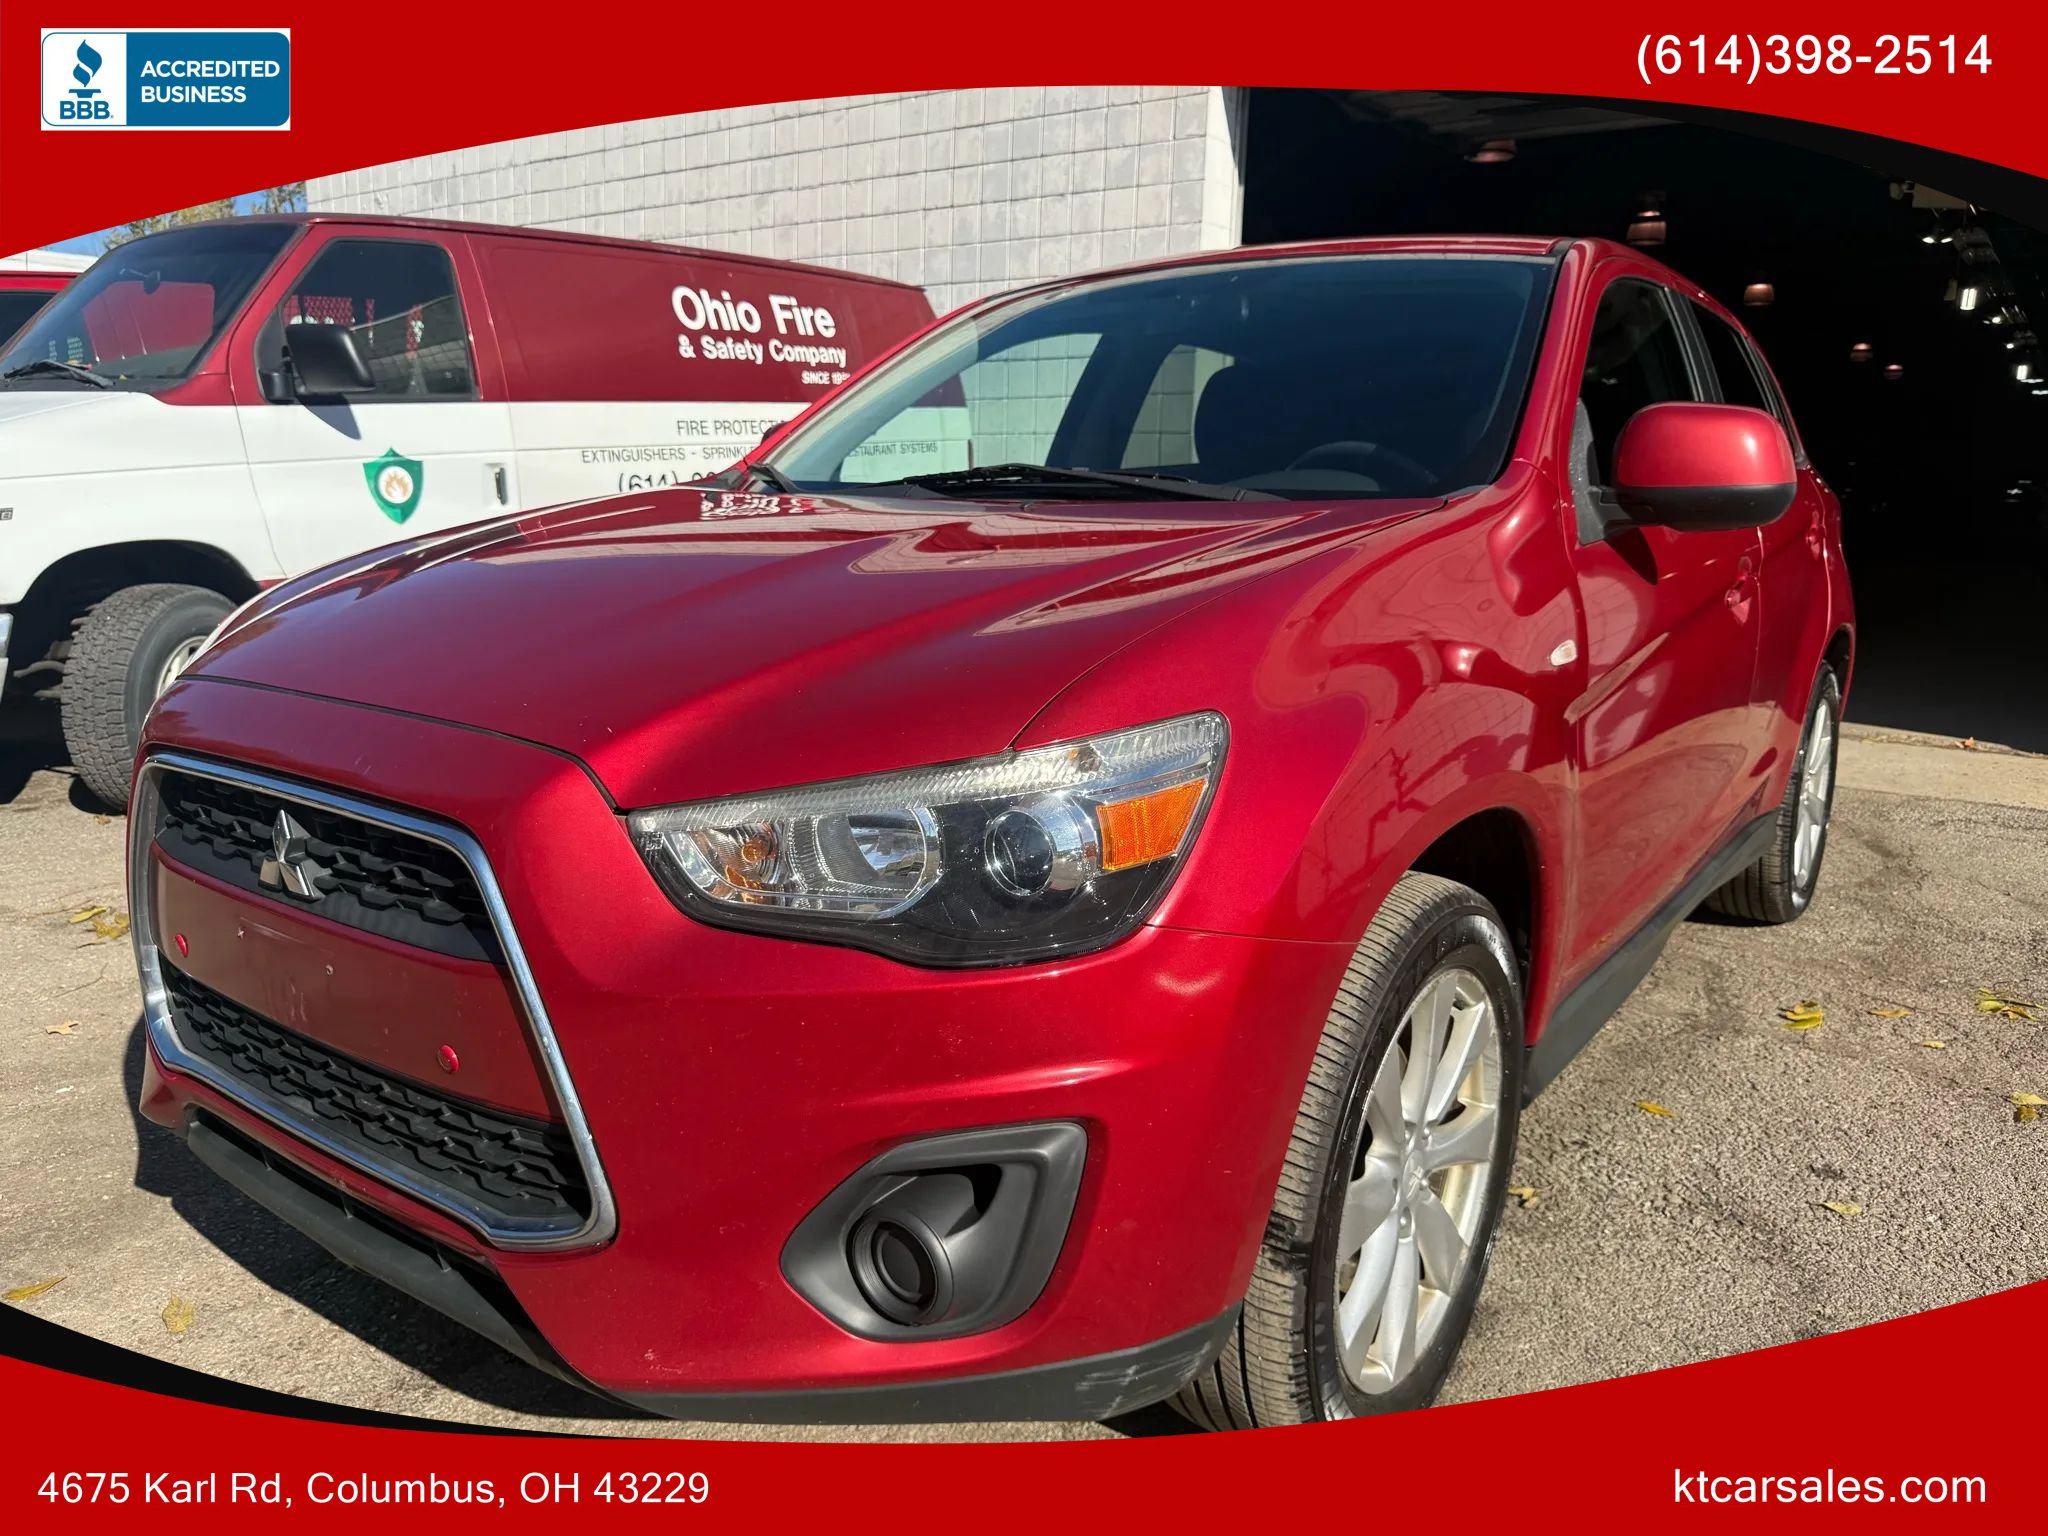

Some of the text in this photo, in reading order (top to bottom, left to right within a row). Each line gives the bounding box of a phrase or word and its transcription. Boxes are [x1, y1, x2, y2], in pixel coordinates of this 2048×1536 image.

[671, 285, 836, 338] Ohio Fire
[678, 334, 847, 368] & Safety Company
[801, 370, 830, 385] SINCE
[676, 419, 785, 436] FIRE PROTECT
[581, 446, 686, 464] EXTINGUISHERS
[899, 442, 938, 455] SYSTEMS
